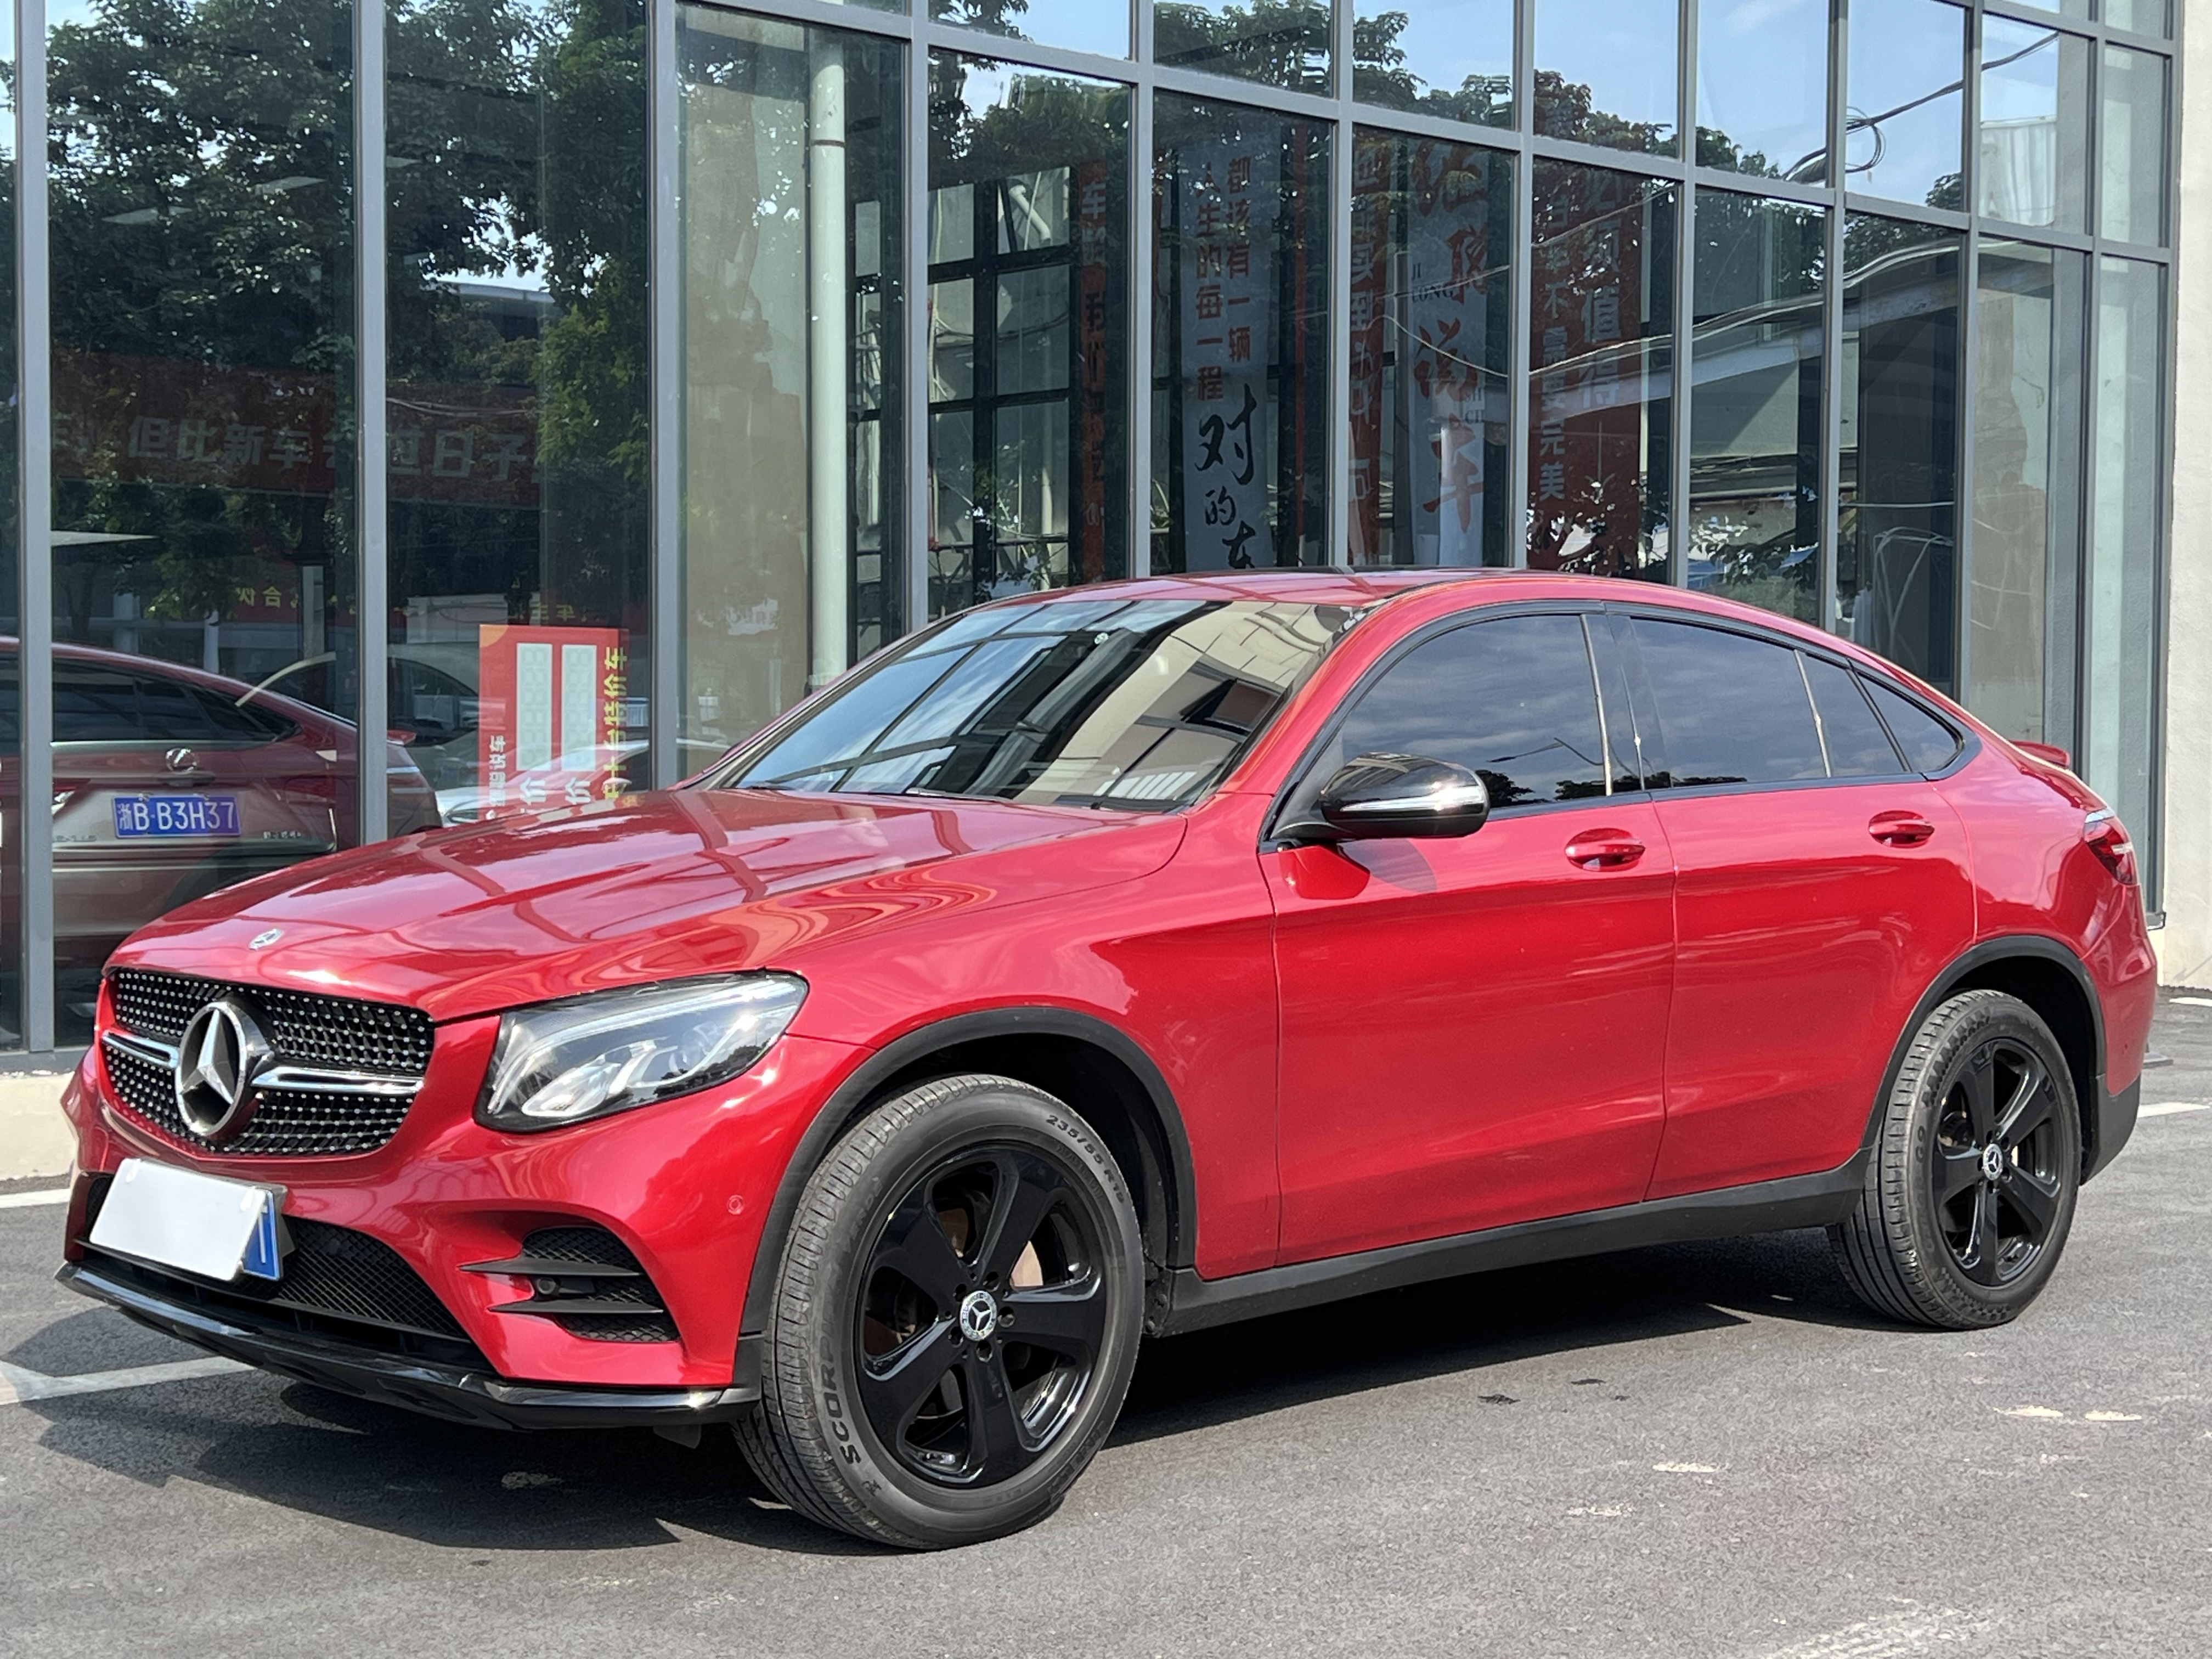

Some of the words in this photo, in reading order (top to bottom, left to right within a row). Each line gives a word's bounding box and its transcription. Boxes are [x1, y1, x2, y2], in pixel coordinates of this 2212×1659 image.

[1195, 162, 1223, 401] 人生的每一程
[1226, 156, 1251, 362] 都该有一辆
[1046, 1114, 1104, 1165] 235/55
